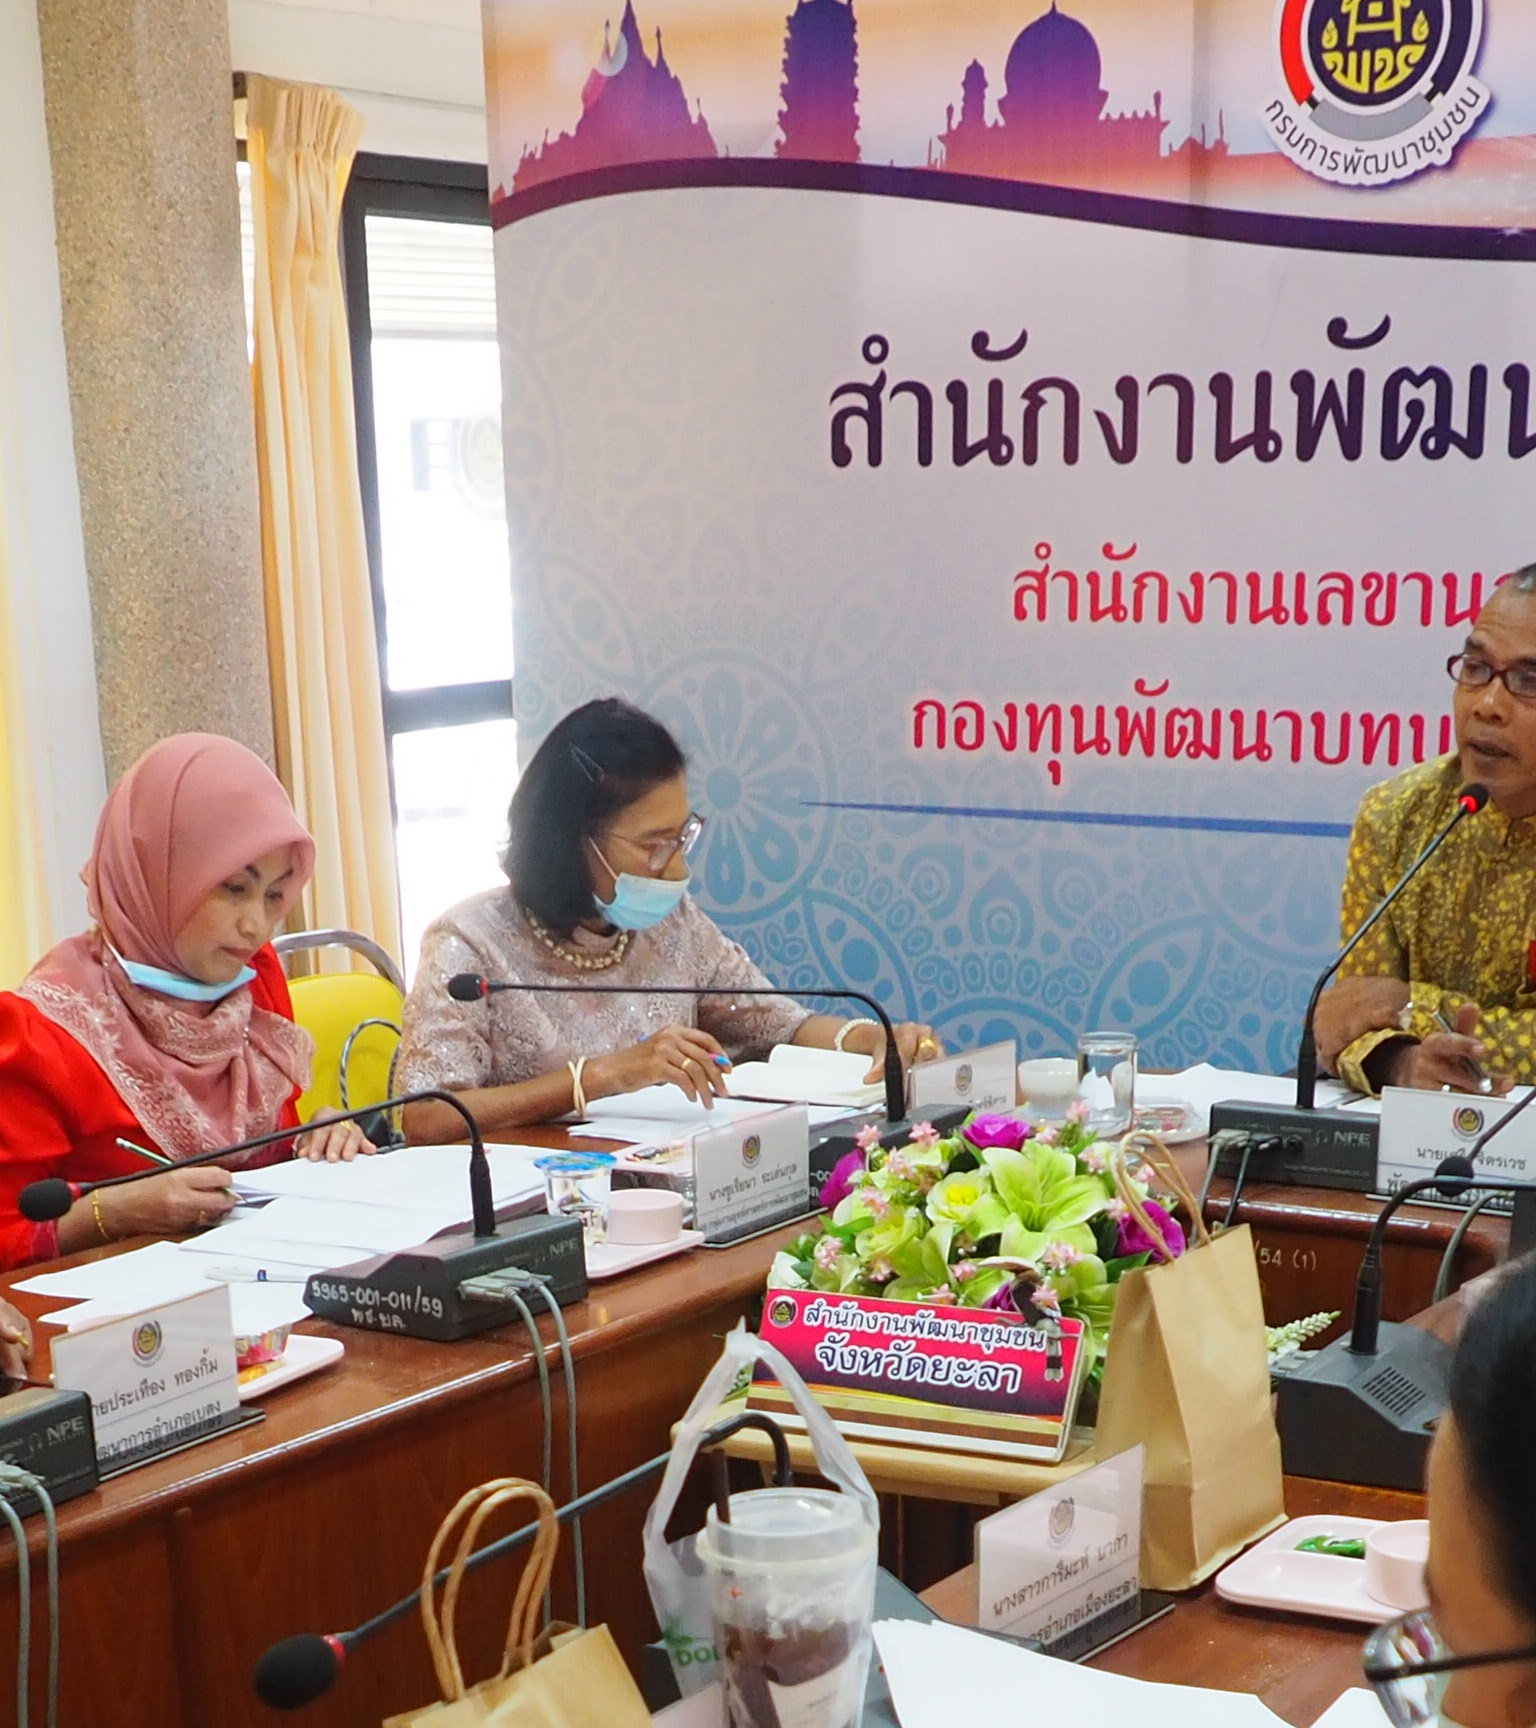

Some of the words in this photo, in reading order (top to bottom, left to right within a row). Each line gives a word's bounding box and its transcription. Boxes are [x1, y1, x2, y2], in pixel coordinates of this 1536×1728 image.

[1264, 85, 1481, 176] กรมการพัฒนาชุมชน
[1333, 1129, 1371, 1145] NPE
[311, 1280, 444, 1319] 5965-001-011/59
[804, 1298, 1047, 1353] สำนักงานพัฒนาชุมชน
[817, 1334, 1021, 1394] จังหวัดยะลา
[91, 1378, 167, 1418] ายประเทือง
[46, 1415, 86, 1442] NPE
[95, 1400, 222, 1460] ฒนาการอำเภอเบตง
